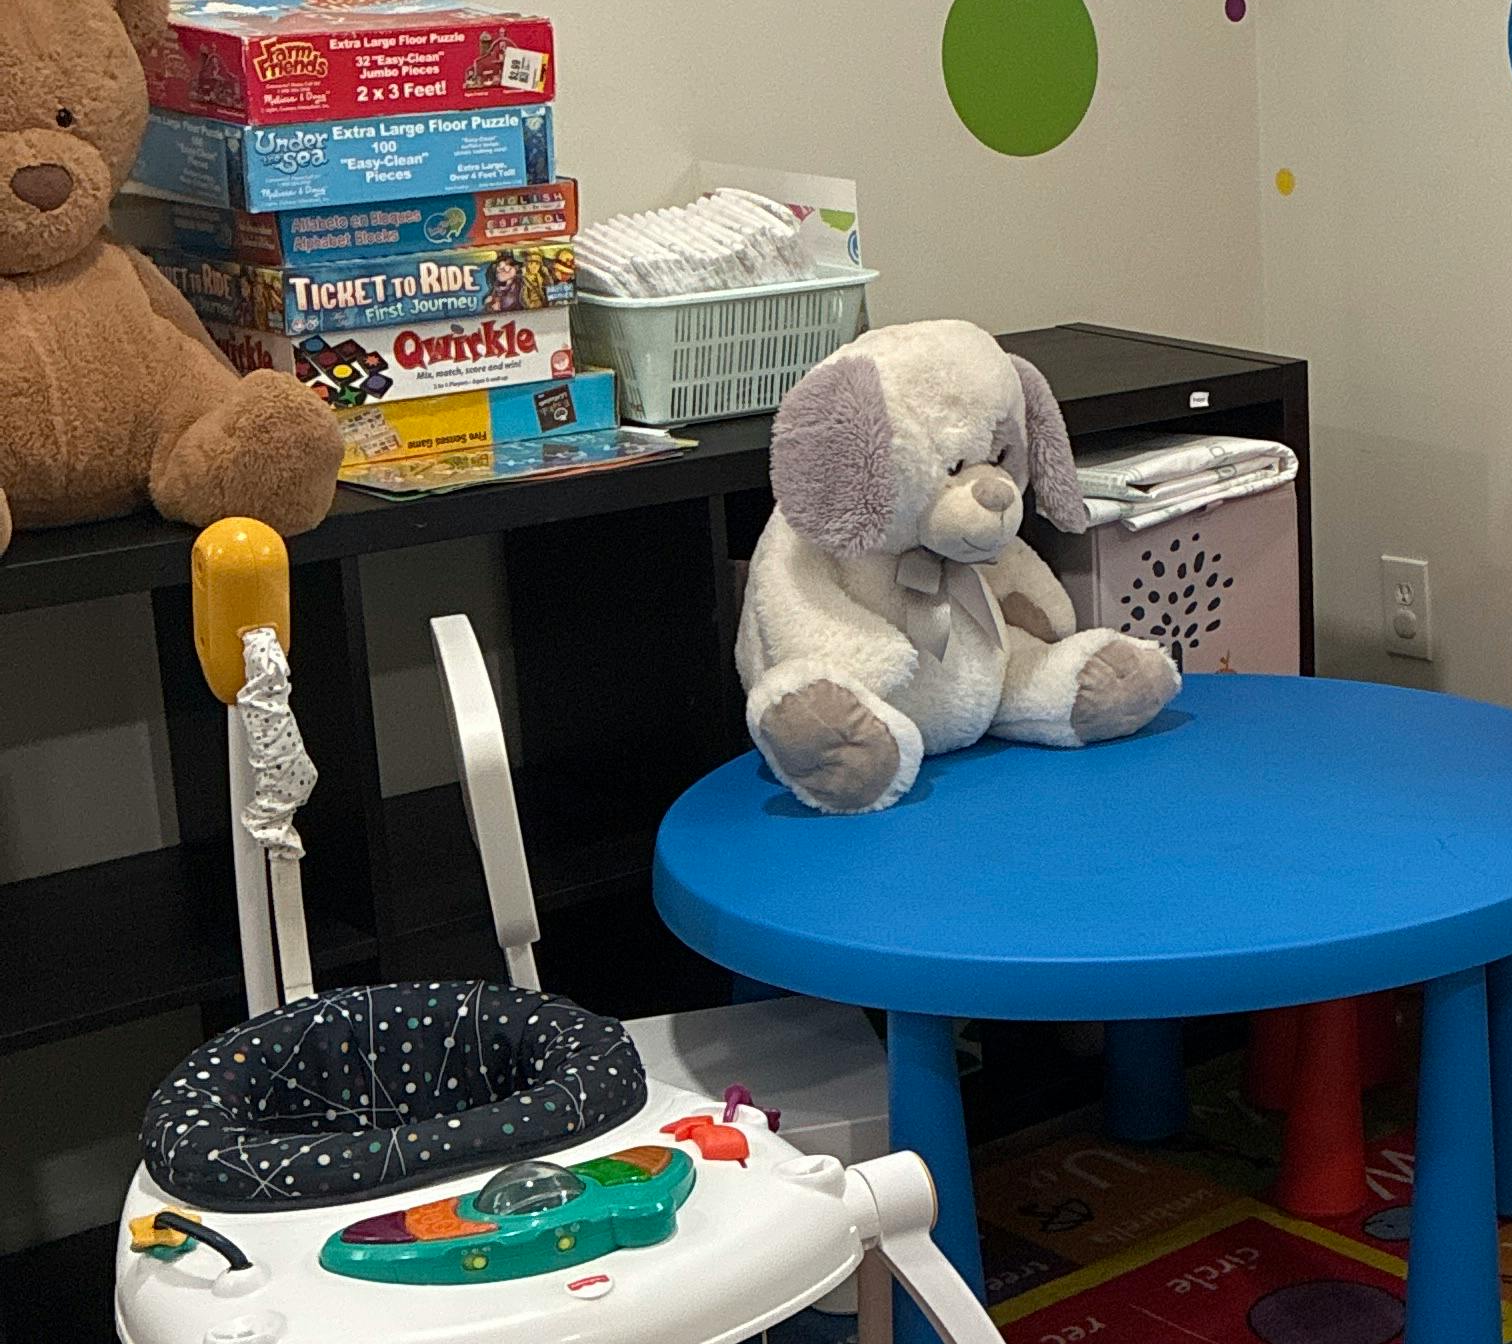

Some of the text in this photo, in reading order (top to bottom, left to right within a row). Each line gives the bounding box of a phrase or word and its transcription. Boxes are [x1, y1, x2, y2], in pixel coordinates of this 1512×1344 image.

[258, 37, 315, 61] Farm
[329, 31, 465, 50] Extra Large Floor Puzzle
[253, 52, 329, 83] Friends
[355, 56, 371, 67] 32
[359, 64, 440, 79] Jumbo Pieces
[356, 80, 447, 102] 2 x 3 Feet!
[332, 114, 519, 140] Extra Large Floor Puzzle
[254, 131, 329, 155] Under
[371, 141, 397, 153] 100
[340, 152, 429, 171] "Easy-Clean"
[365, 170, 412, 183] Pieces
[289, 262, 481, 311] TICKET TO RIDE
[365, 295, 477, 323] First Journey
[393, 320, 538, 370] Qwirkle
[465, 364, 487, 375] score
[488, 362, 504, 372] and
[408, 430, 487, 449] Five Senses Game
[1168, 1251, 1258, 1293] circle
